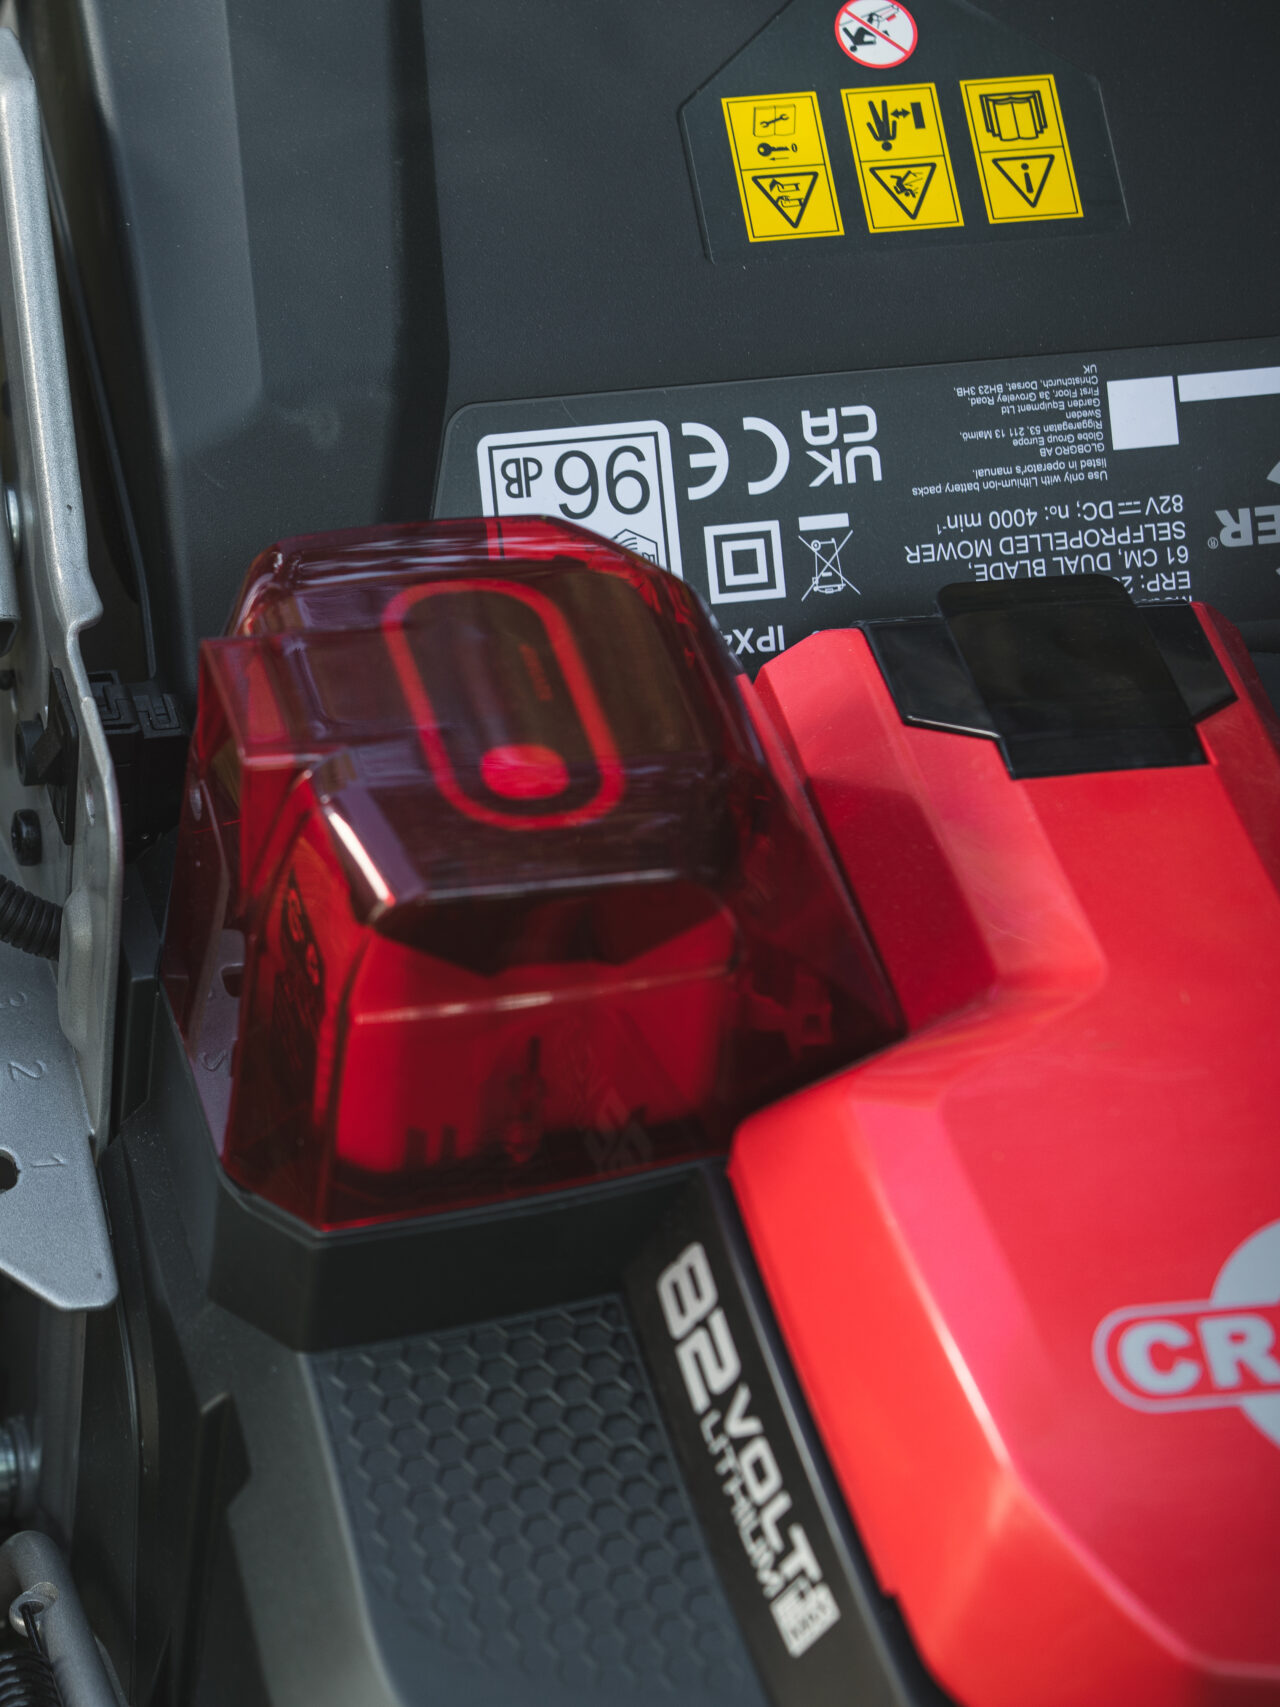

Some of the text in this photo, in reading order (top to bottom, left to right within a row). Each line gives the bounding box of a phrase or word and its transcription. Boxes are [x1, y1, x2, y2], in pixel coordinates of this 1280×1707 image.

[1082, 363, 1098, 374] UK
[978, 383, 1004, 395] BH23
[1039, 390, 1050, 401] 3a
[1079, 386, 1099, 397] First
[997, 391, 1037, 404] Groveley
[1001, 397, 1100, 415] Garden Equipment Ltd
[1065, 408, 1102, 420] Sweden
[995, 429, 1005, 439] 13
[1009, 427, 1025, 438] 211
[1012, 431, 1104, 447] Globe Group Europe
[1039, 442, 1105, 457] GLOBGRO AB
[681, 417, 790, 500] CE
[972, 458, 1107, 479] listed in operator's manual.
[1087, 470, 1108, 481] Use
[500, 445, 650, 520] 96 dB
[1040, 474, 1061, 486] with
[1063, 471, 1085, 484] only
[911, 483, 942, 497] packs
[944, 481, 980, 493] battery
[1145, 494, 1183, 516] 82V
[988, 507, 1038, 530] 4000
[904, 521, 1186, 564] SELFPROPELLED MOWER
[968, 545, 1189, 582] 61 CM, DUAL BLADE,
[1140, 571, 1191, 592] ERP:
[7, 1059, 48, 1082] 2
[30, 1152, 67, 1169] 1
[656, 1241, 824, 1585] 82 VOLT
